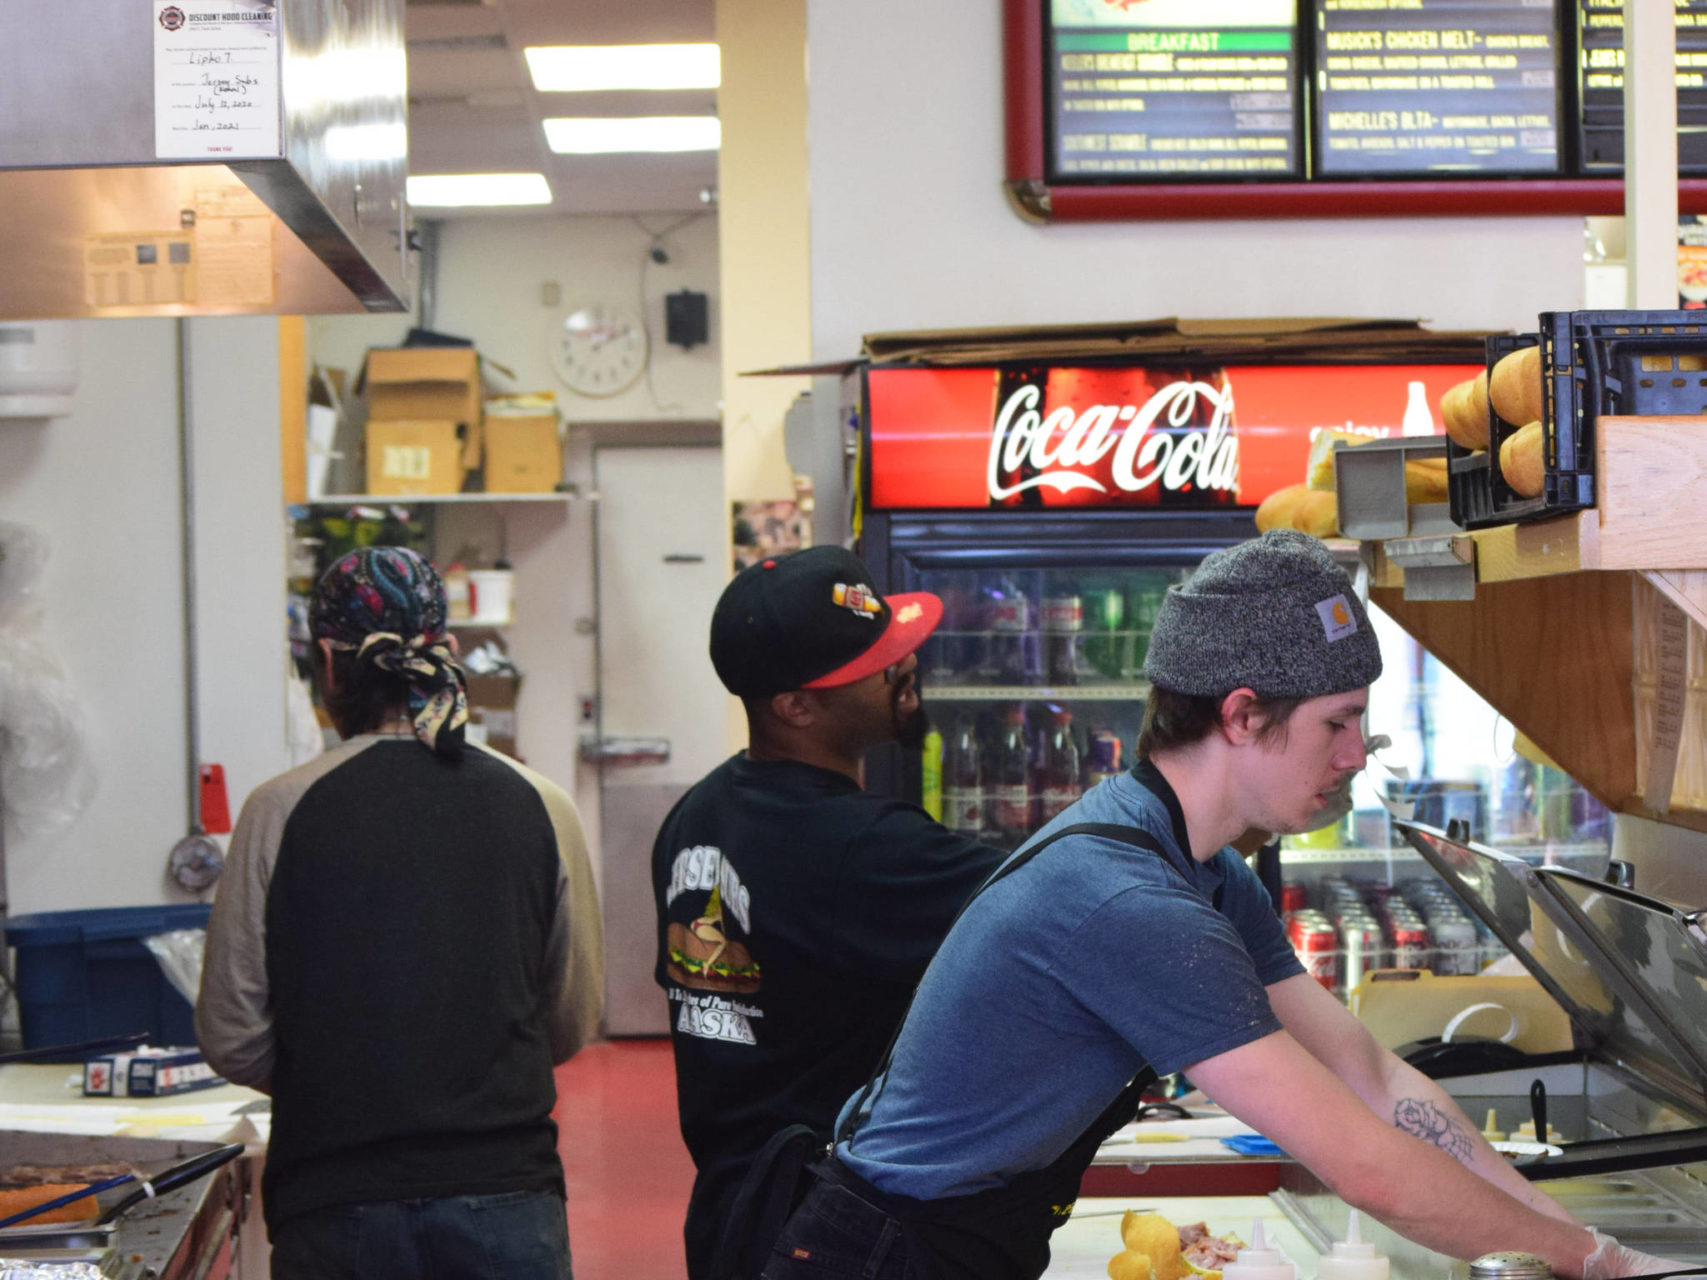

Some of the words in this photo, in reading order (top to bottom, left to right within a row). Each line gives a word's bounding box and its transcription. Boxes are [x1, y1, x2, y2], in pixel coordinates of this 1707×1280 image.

[189, 13, 220, 21] DISCOUNT
[222, 13, 240, 21] HOOD
[241, 12, 272, 20] CLEANING
[1127, 33, 1219, 51] BREAKFAST
[1385, 31, 1439, 49] CHICKEN
[195, 95, 215, 114] July
[987, 381, 1241, 499] Coca-Cola
[677, 1002, 757, 1046] AASKA
